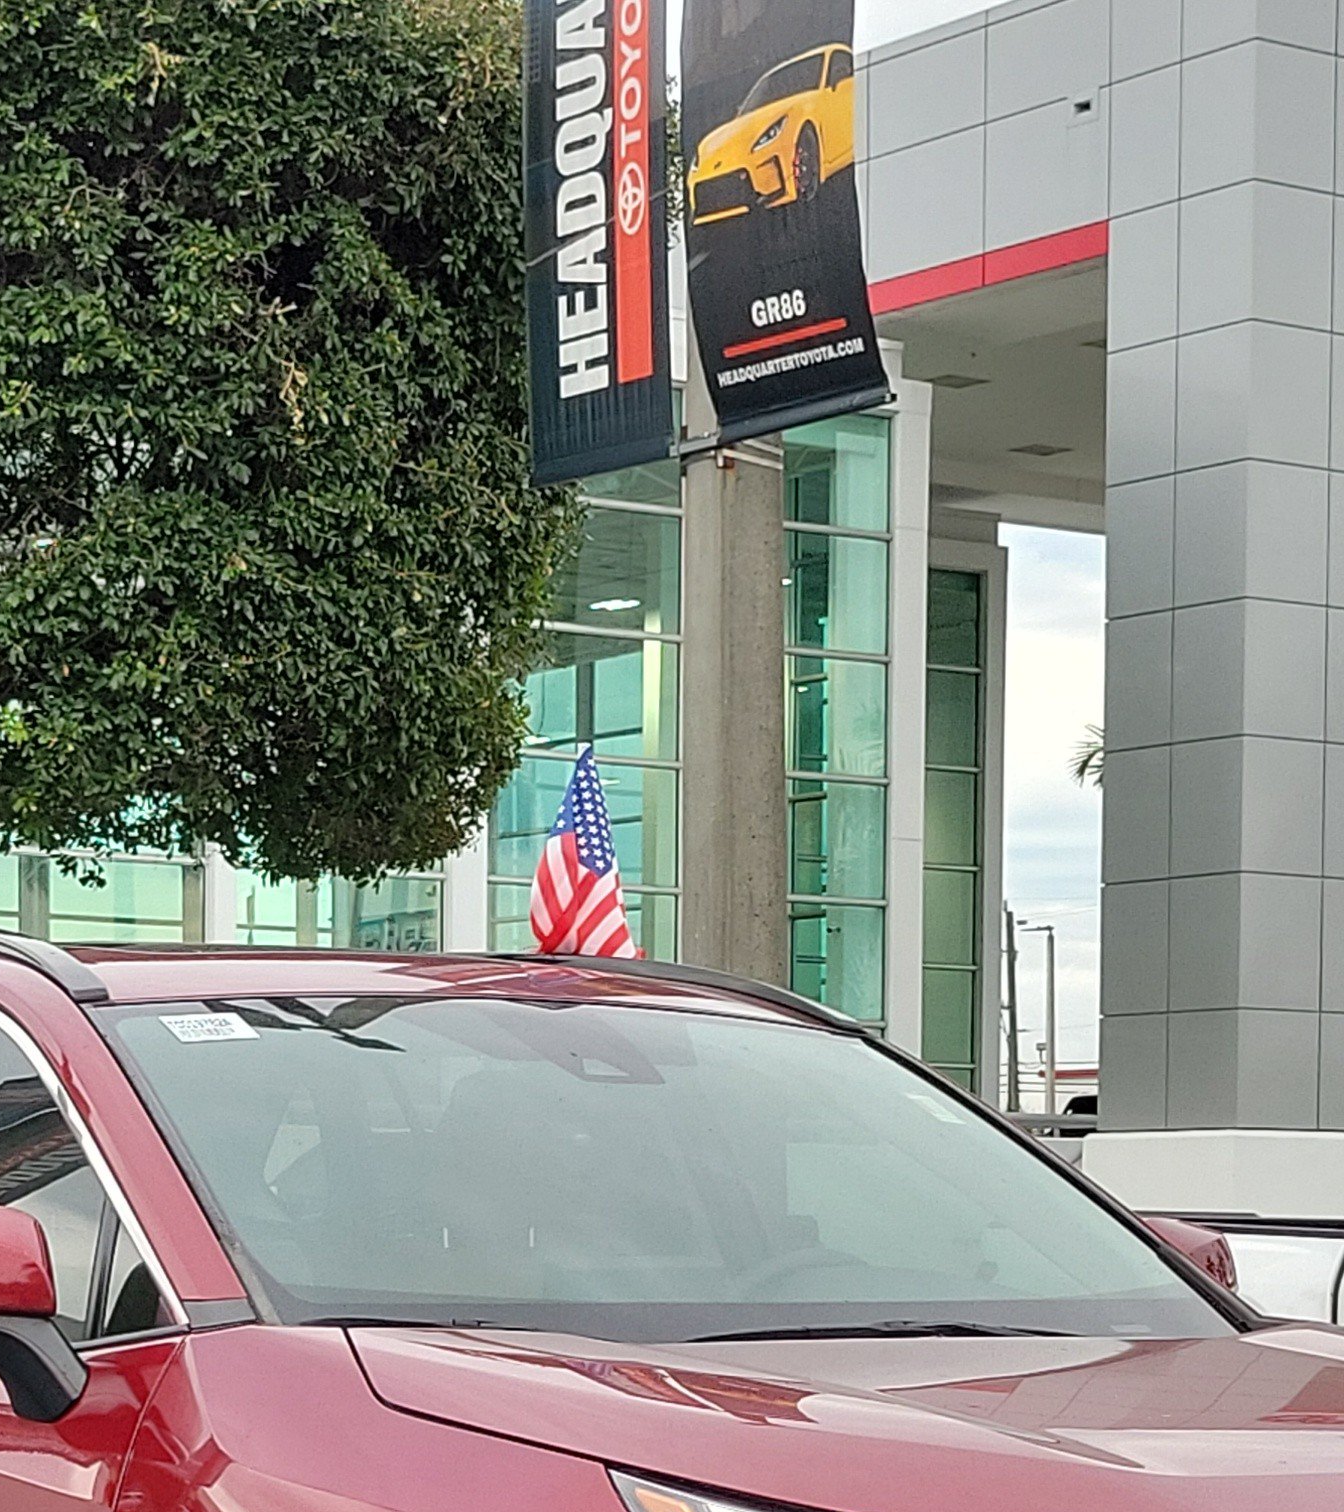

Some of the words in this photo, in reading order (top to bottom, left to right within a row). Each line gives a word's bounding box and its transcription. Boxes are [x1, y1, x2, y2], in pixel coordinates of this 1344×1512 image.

[555, 0, 613, 399] HEADQUA
[750, 289, 806, 327] GR86
[716, 337, 865, 388] HEADQUARTERTOYOTA.COM
